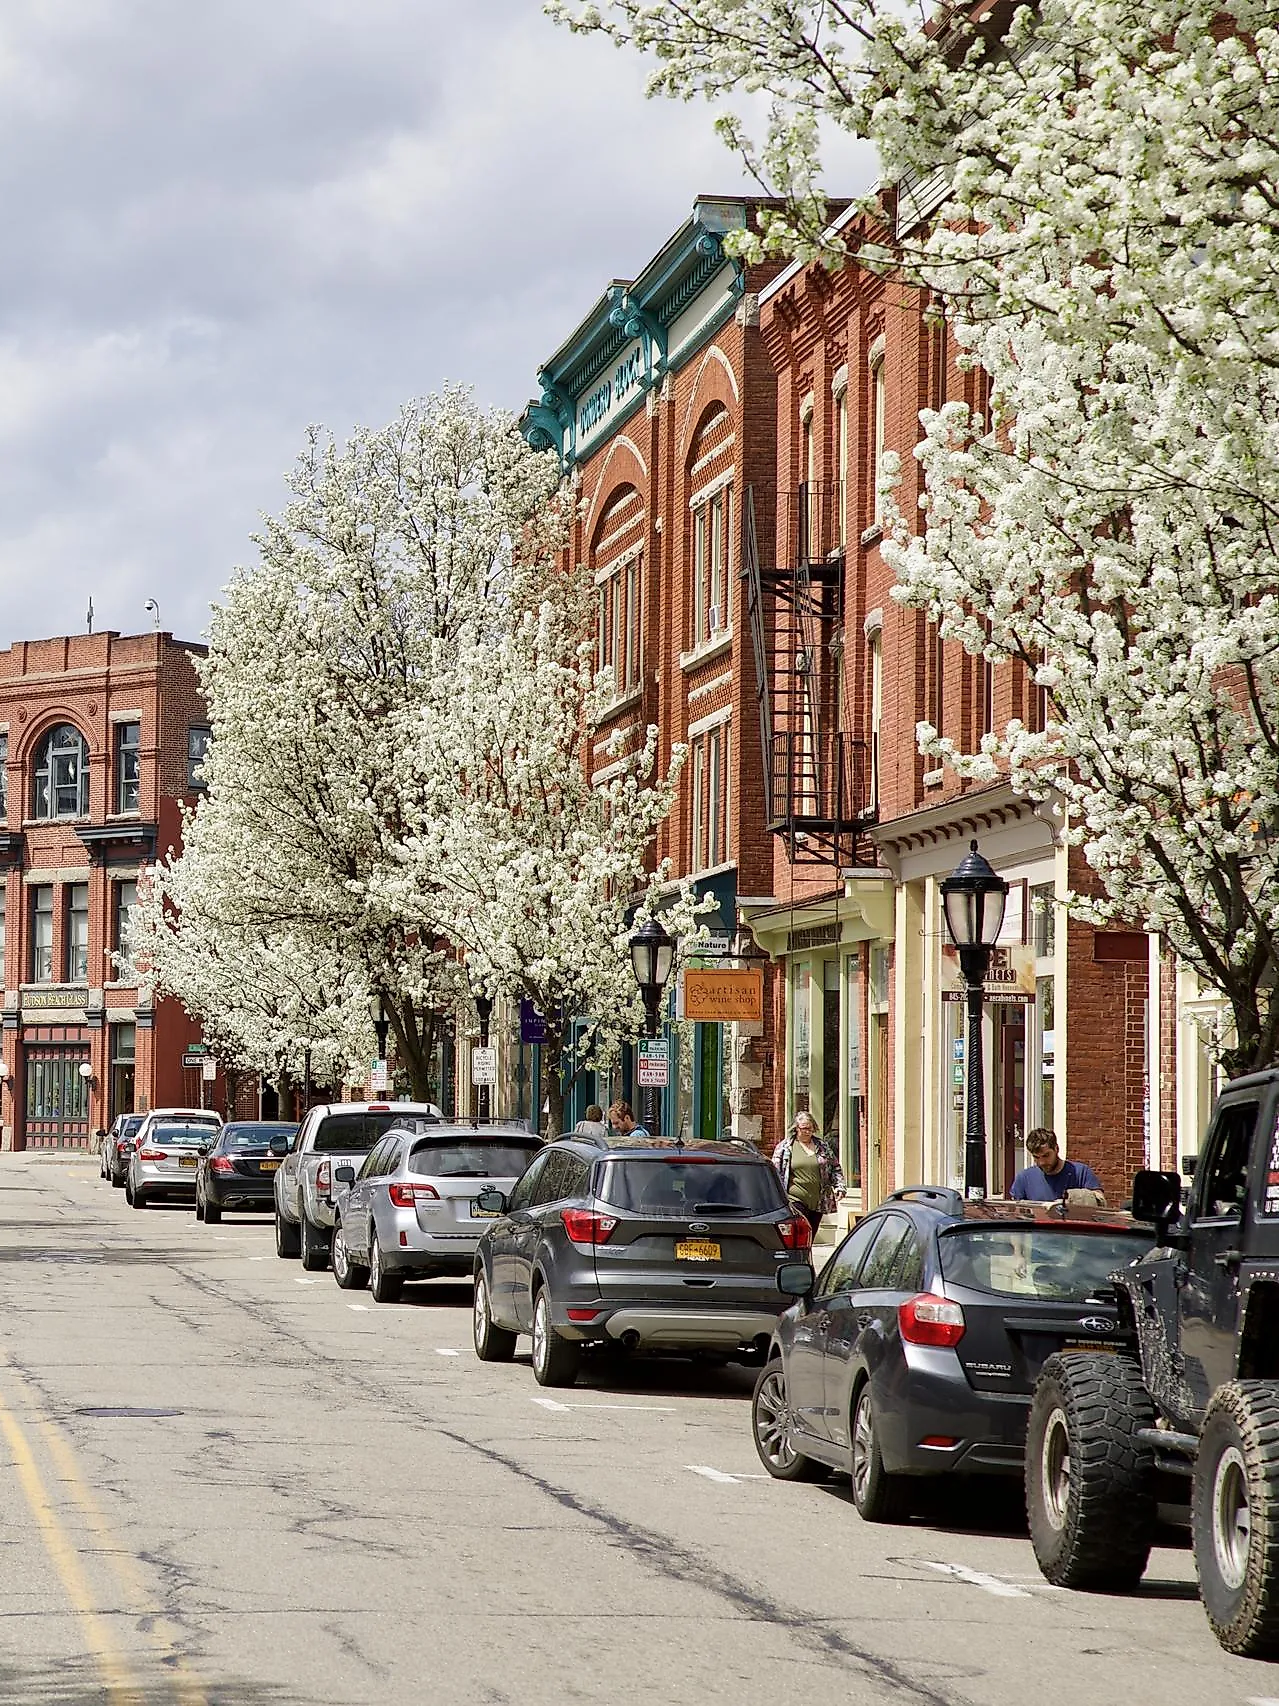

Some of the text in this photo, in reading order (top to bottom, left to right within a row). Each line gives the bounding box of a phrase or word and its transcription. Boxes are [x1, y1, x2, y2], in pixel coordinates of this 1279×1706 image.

[698, 941, 727, 949] Nature
[708, 985, 756, 994] artisan
[736, 994, 756, 1006] shop
[641, 1042, 647, 1051] 2
[639, 1060, 648, 1069] NO
[965, 1362, 1012, 1371] SUBARU
